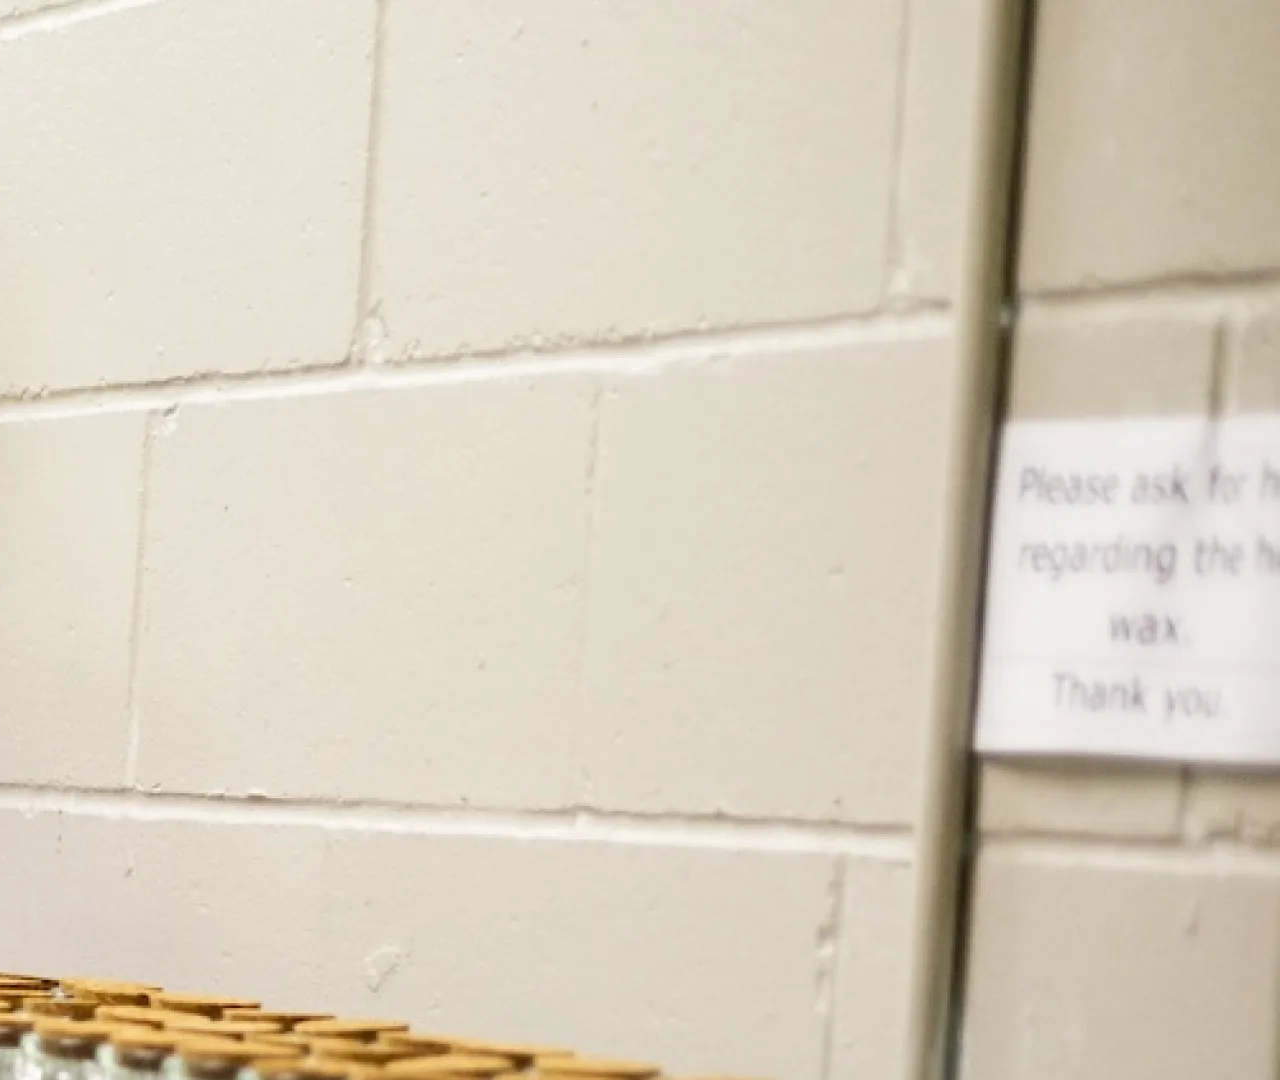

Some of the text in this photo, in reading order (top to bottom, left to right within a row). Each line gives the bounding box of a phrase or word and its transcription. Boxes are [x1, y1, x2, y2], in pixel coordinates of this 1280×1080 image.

[1018, 466, 1121, 505] Please
[1130, 463, 1190, 505] ask
[1207, 463, 1248, 506] for
[1018, 535, 1178, 585] regarding
[1193, 533, 1246, 578] the
[1051, 671, 1150, 715] Thank
